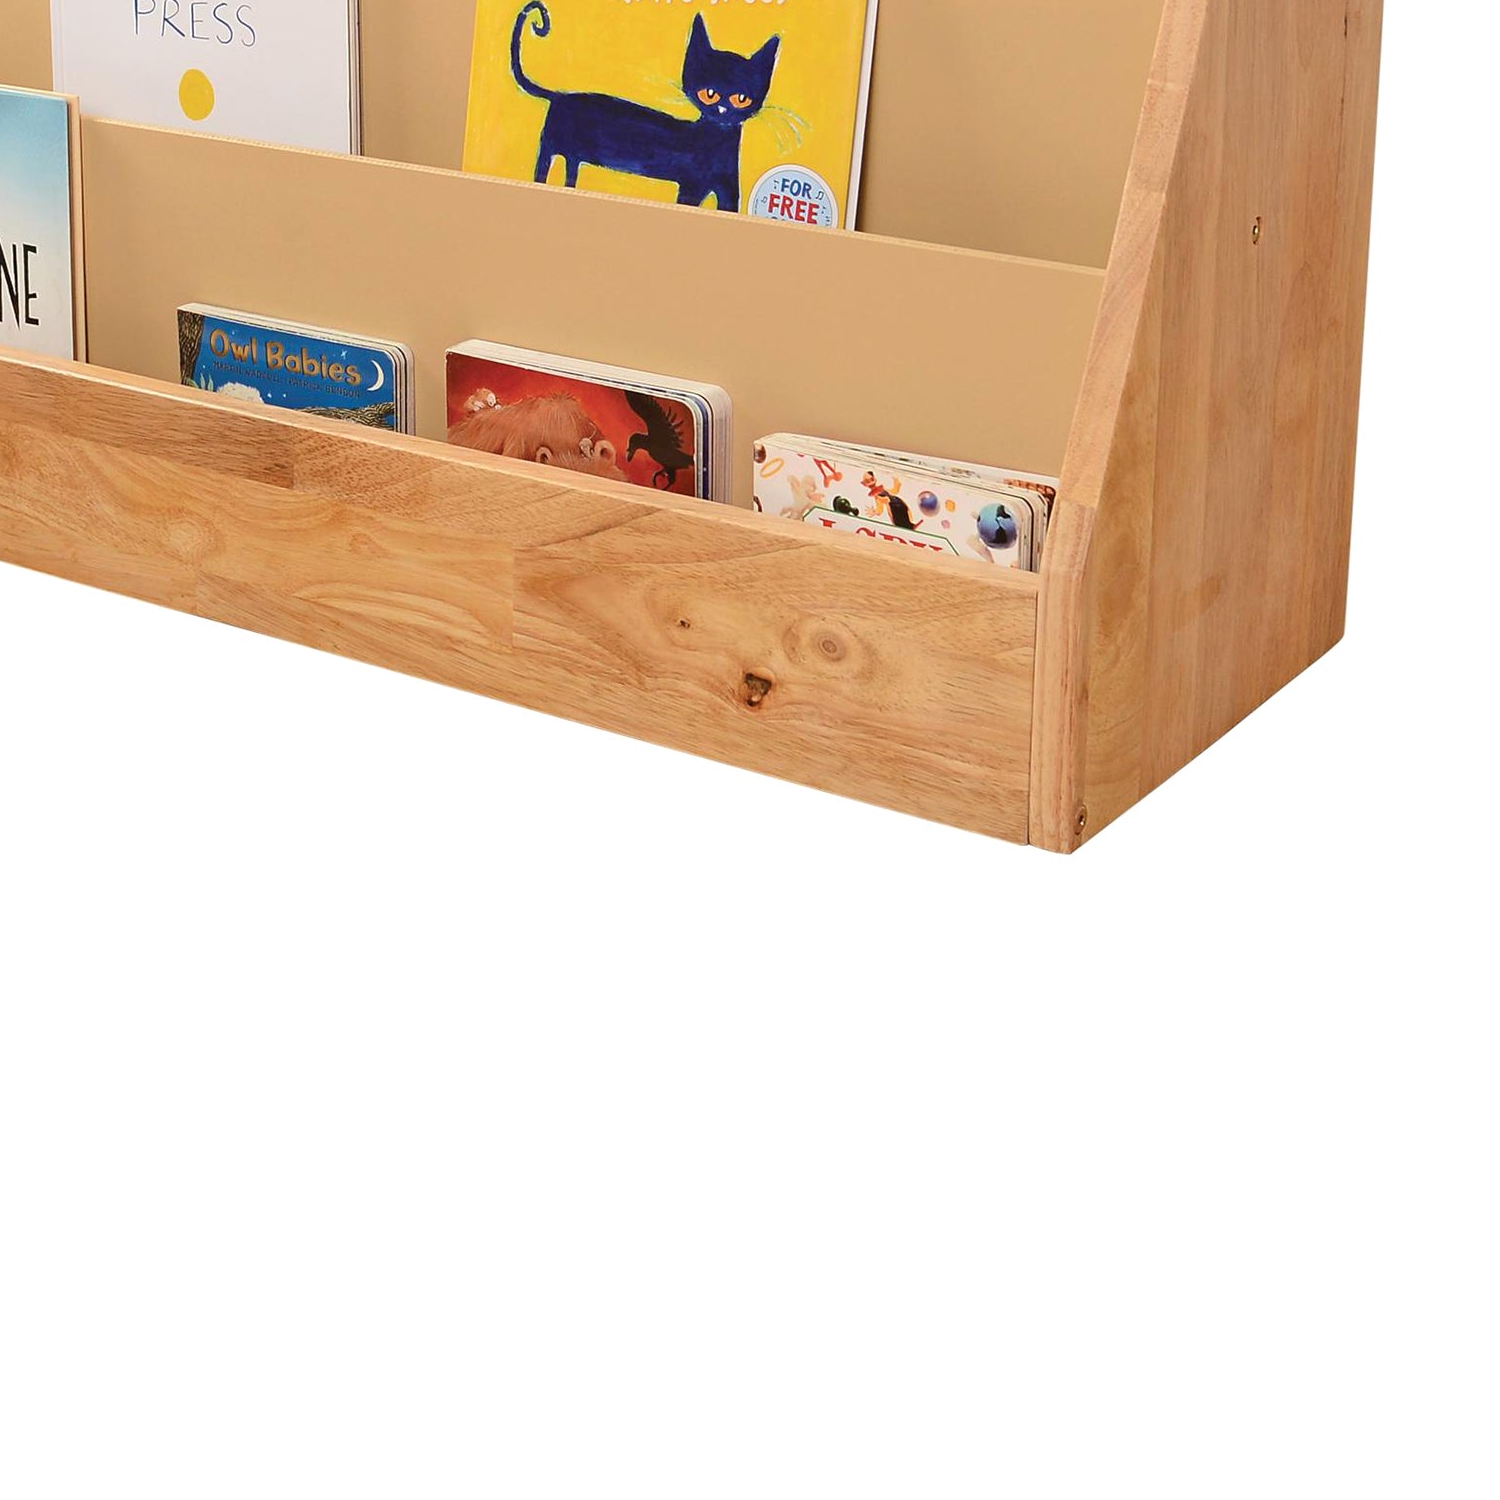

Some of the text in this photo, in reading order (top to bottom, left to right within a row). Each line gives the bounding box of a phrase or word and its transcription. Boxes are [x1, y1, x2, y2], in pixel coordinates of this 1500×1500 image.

[780, 177, 812, 200] FOR
[767, 193, 820, 225] FREE
[210, 328, 258, 364] Owl
[266, 340, 363, 386] Babies
